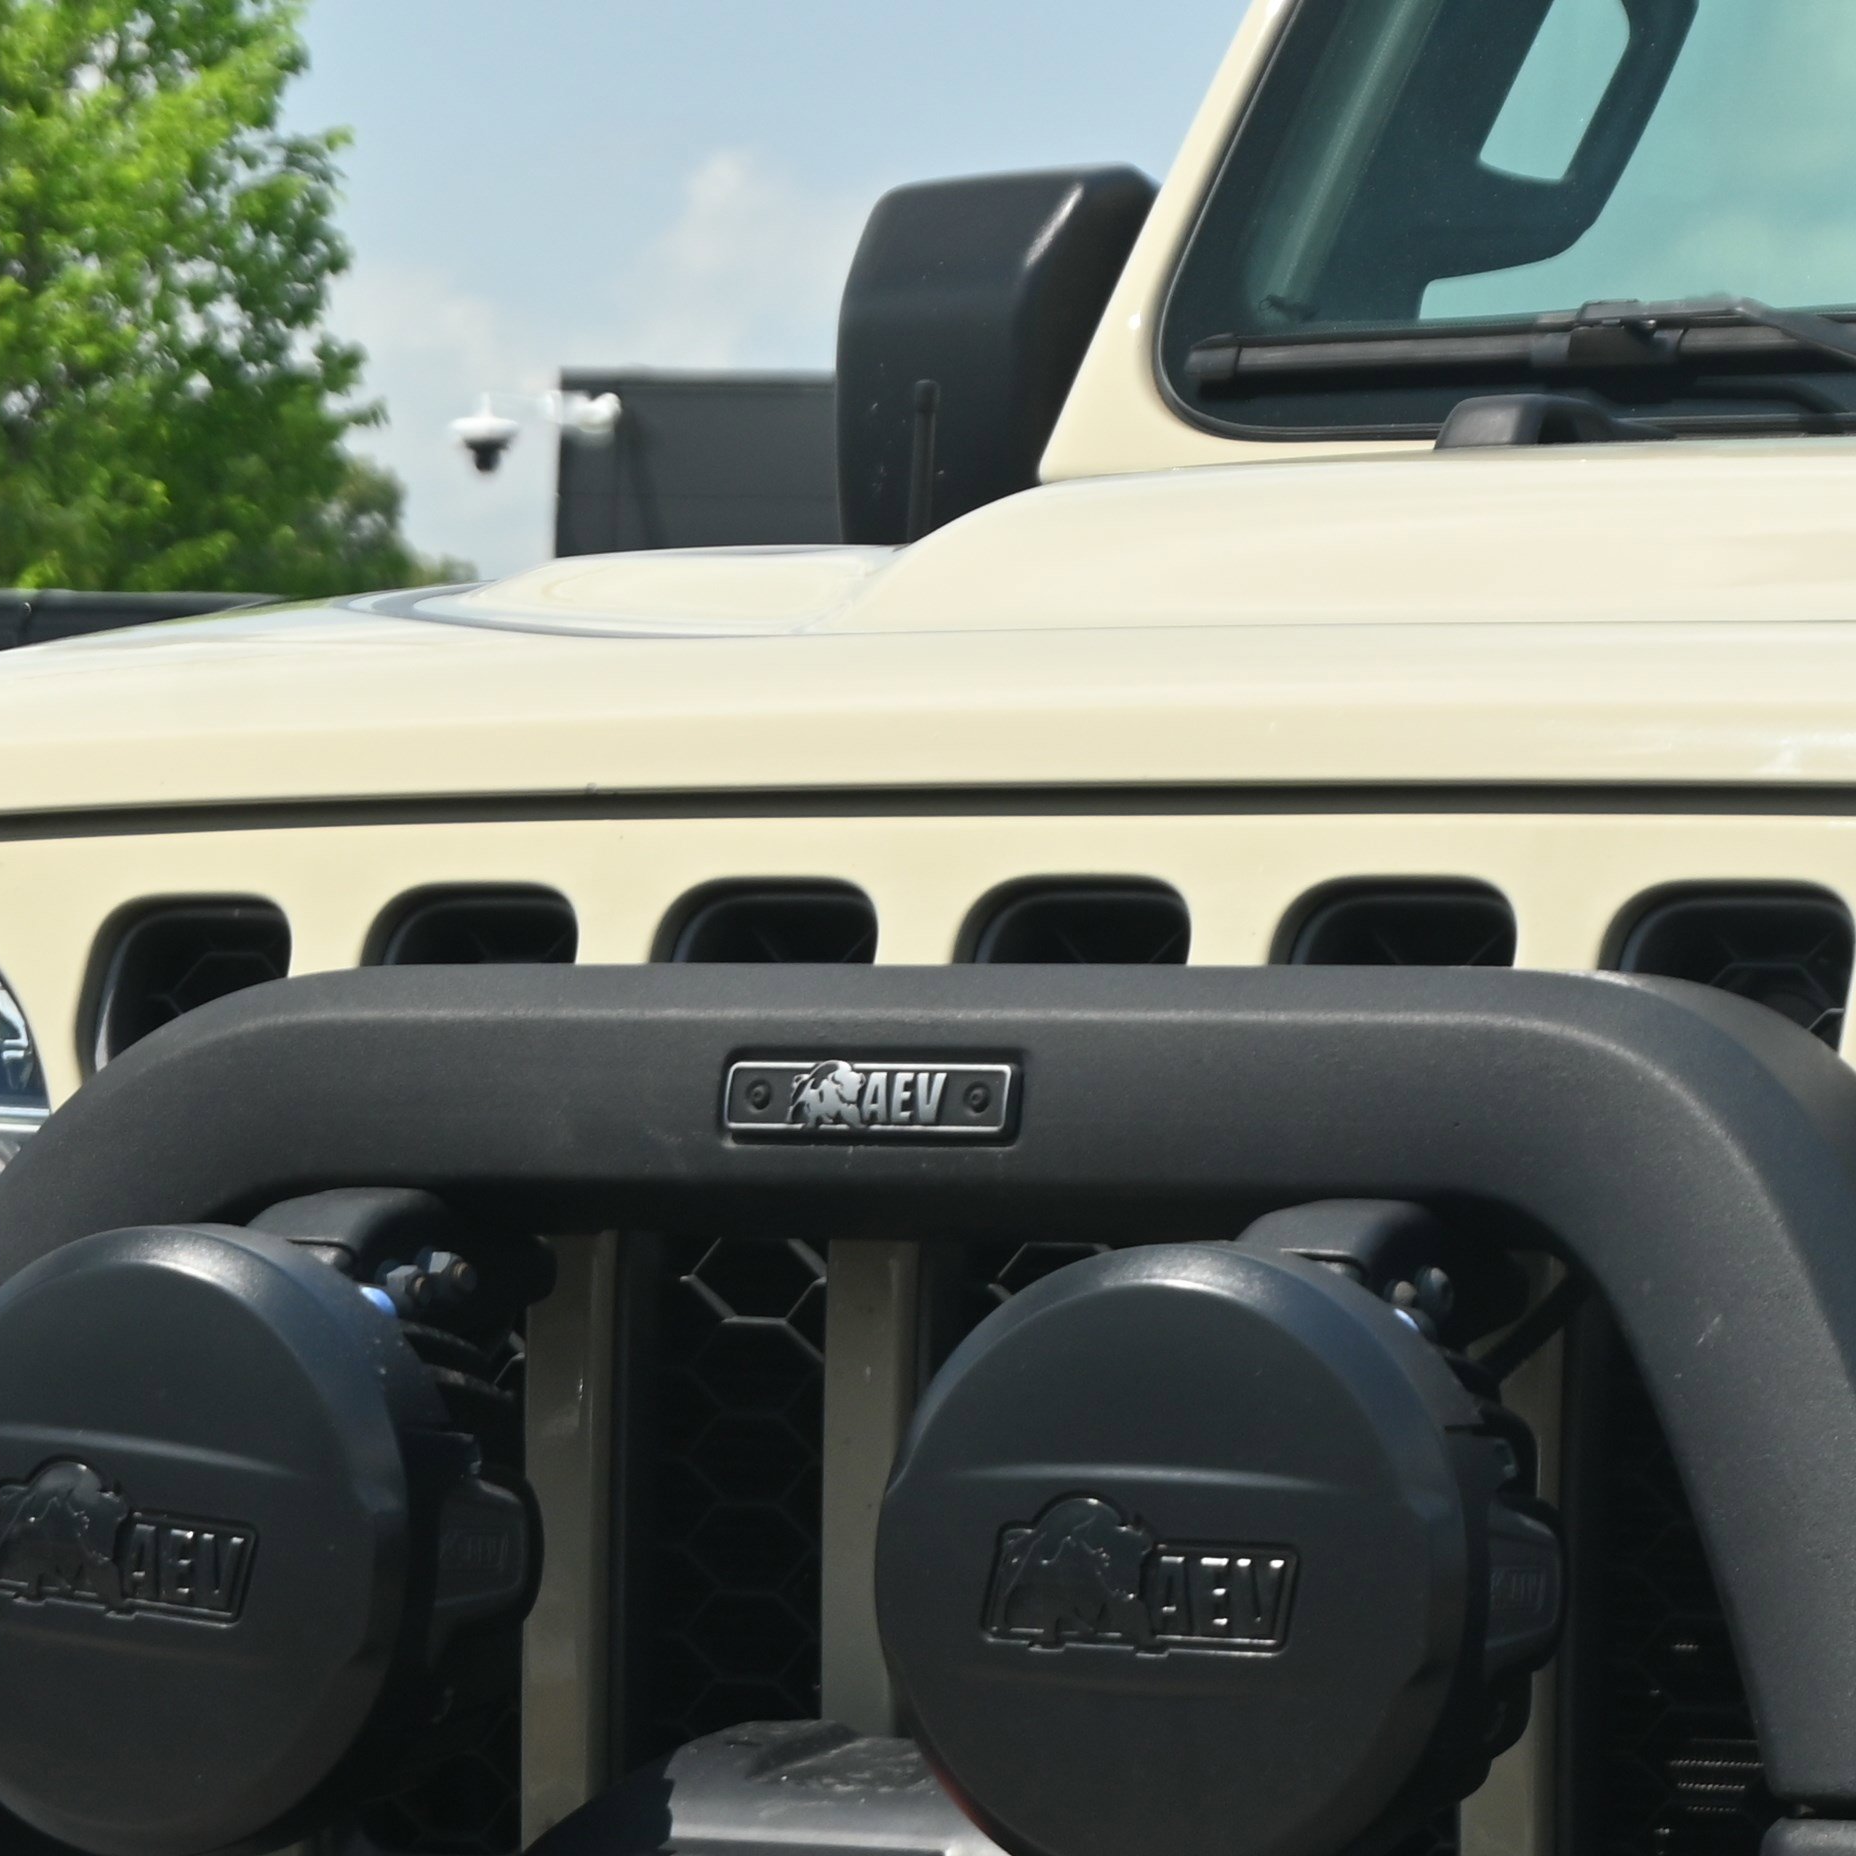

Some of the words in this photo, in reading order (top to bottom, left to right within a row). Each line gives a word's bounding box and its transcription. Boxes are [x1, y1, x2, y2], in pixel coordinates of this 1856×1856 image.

[861, 1071, 948, 1126] AEV
[123, 1522, 246, 1612] AEV
[1151, 1555, 1287, 1637] AEV
